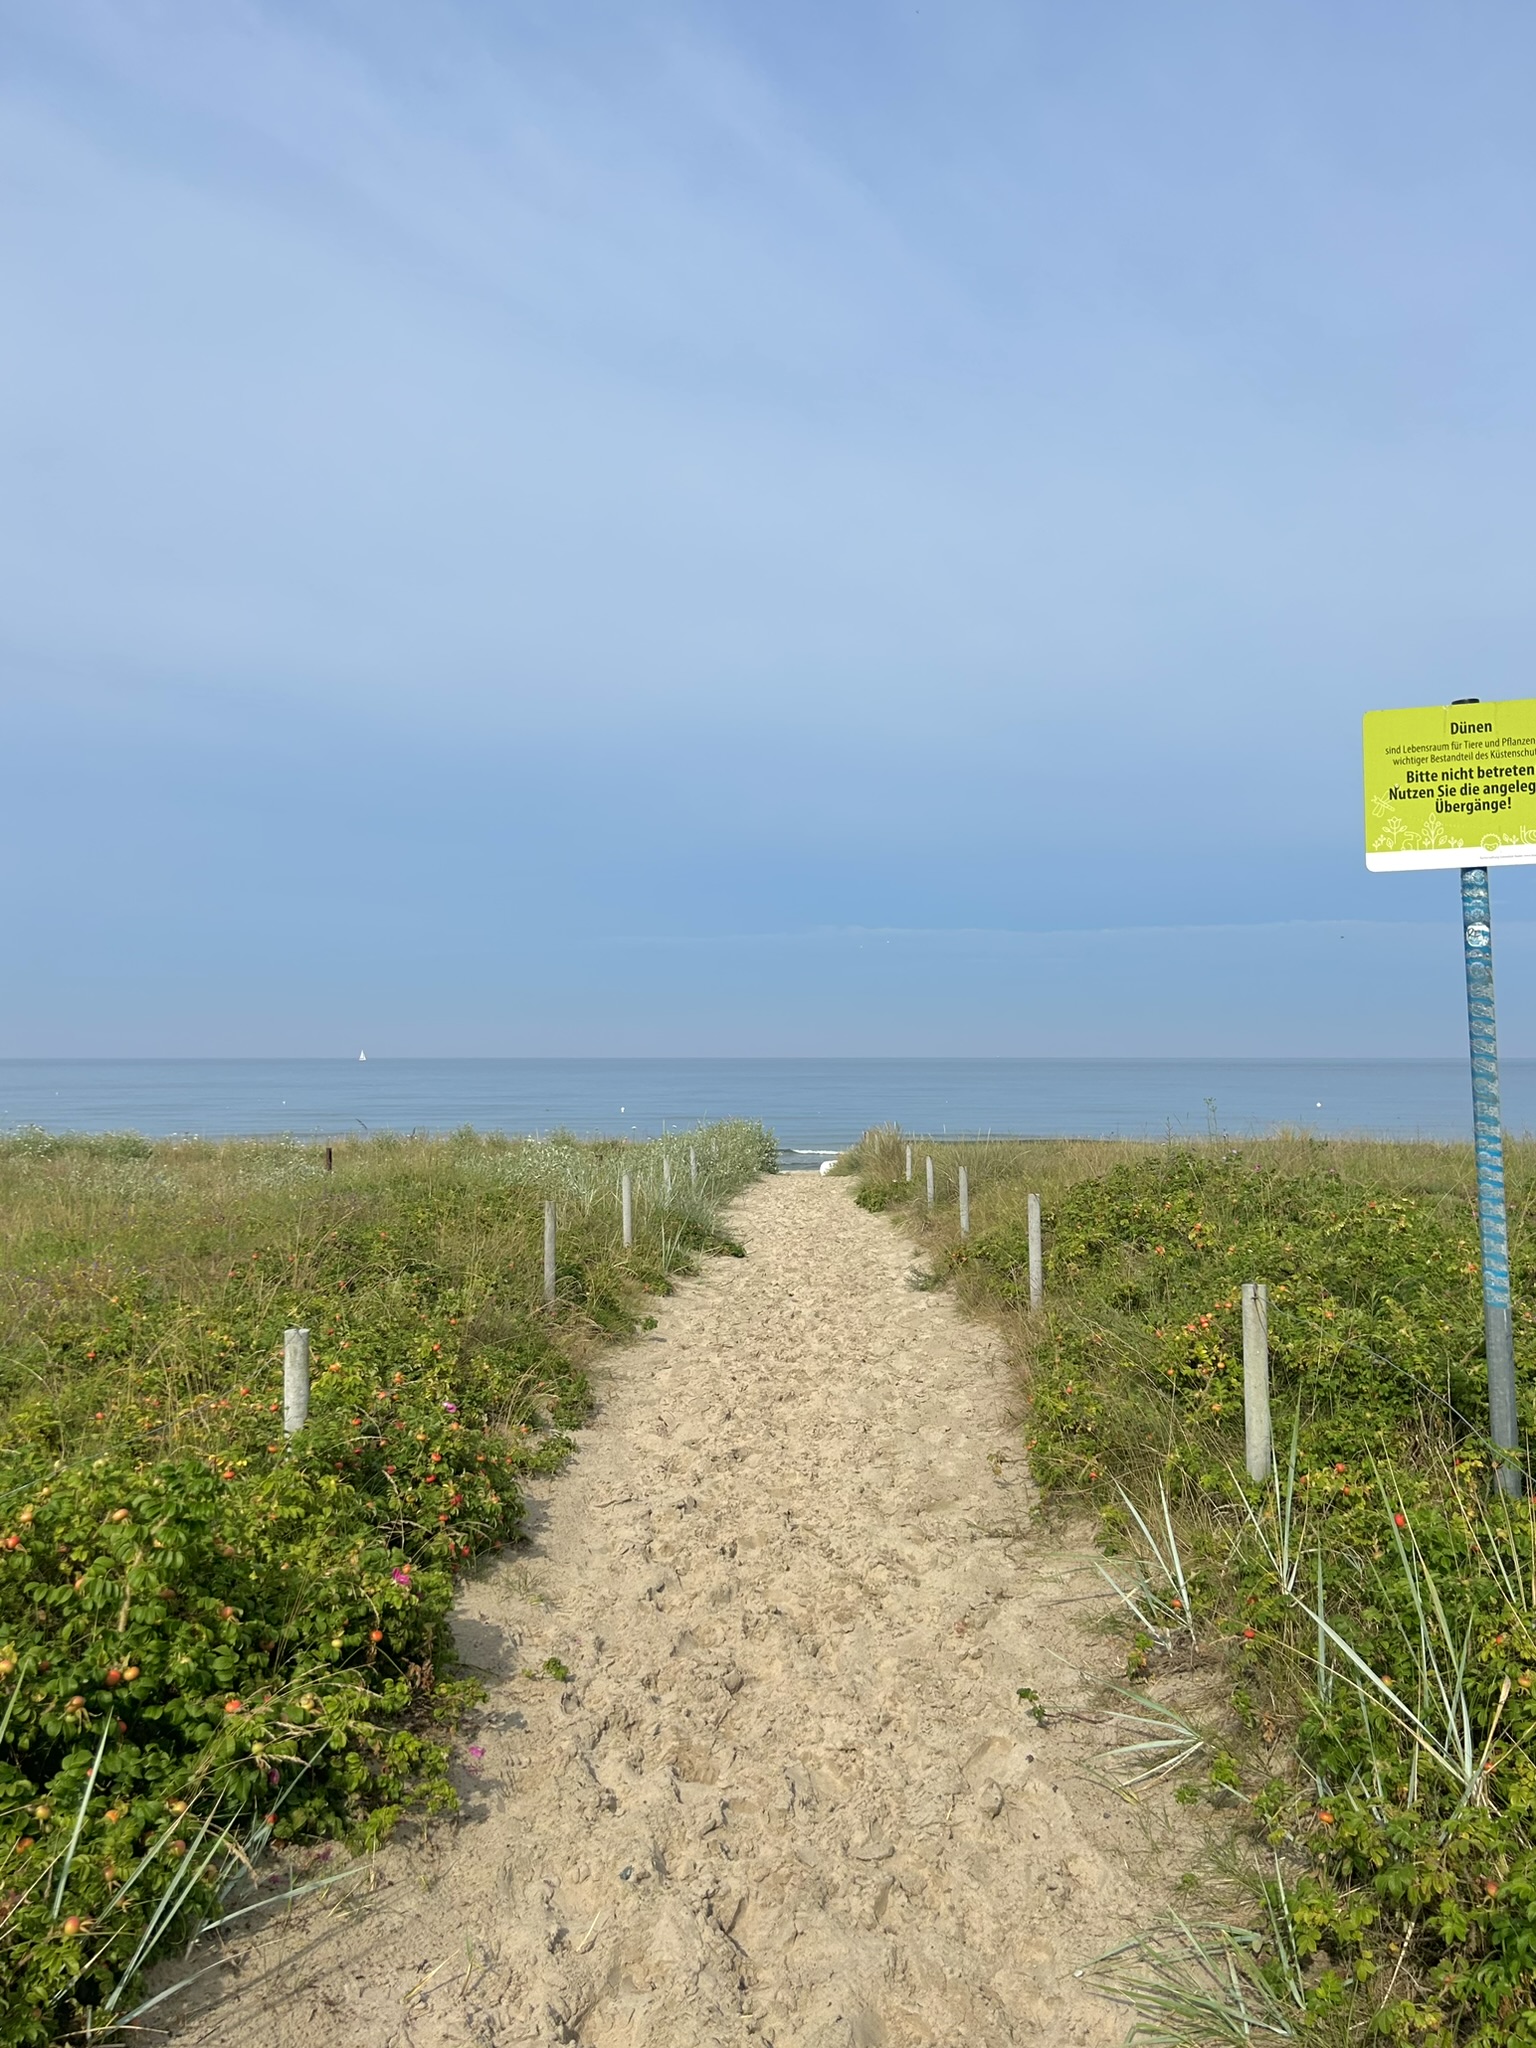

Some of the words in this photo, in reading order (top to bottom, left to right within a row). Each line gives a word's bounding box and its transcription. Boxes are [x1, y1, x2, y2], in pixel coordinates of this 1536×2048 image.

[1450, 721, 1492, 735] Dünen
[1385, 746, 1401, 755] sind
[1403, 743, 1450, 753] Lebensraum
[1451, 741, 1462, 750] für
[1464, 740, 1483, 749] Tiere
[1485, 738, 1500, 748] und
[1502, 737, 1536, 747] Pflanzen
[1393, 756, 1428, 766] wichtiger
[1430, 752, 1473, 763] Bestandteil
[1475, 750, 1488, 760] des
[1406, 770, 1438, 783] Bitte
[1441, 767, 1474, 781] nicht
[1477, 765, 1535, 779] betreten
[1389, 787, 1434, 800] Nutzen
[1437, 784, 1456, 797] Sie
[1460, 783, 1480, 796] die
[1483, 779, 1536, 796] angeleg
[1436, 797, 1511, 815] Übergänge!
